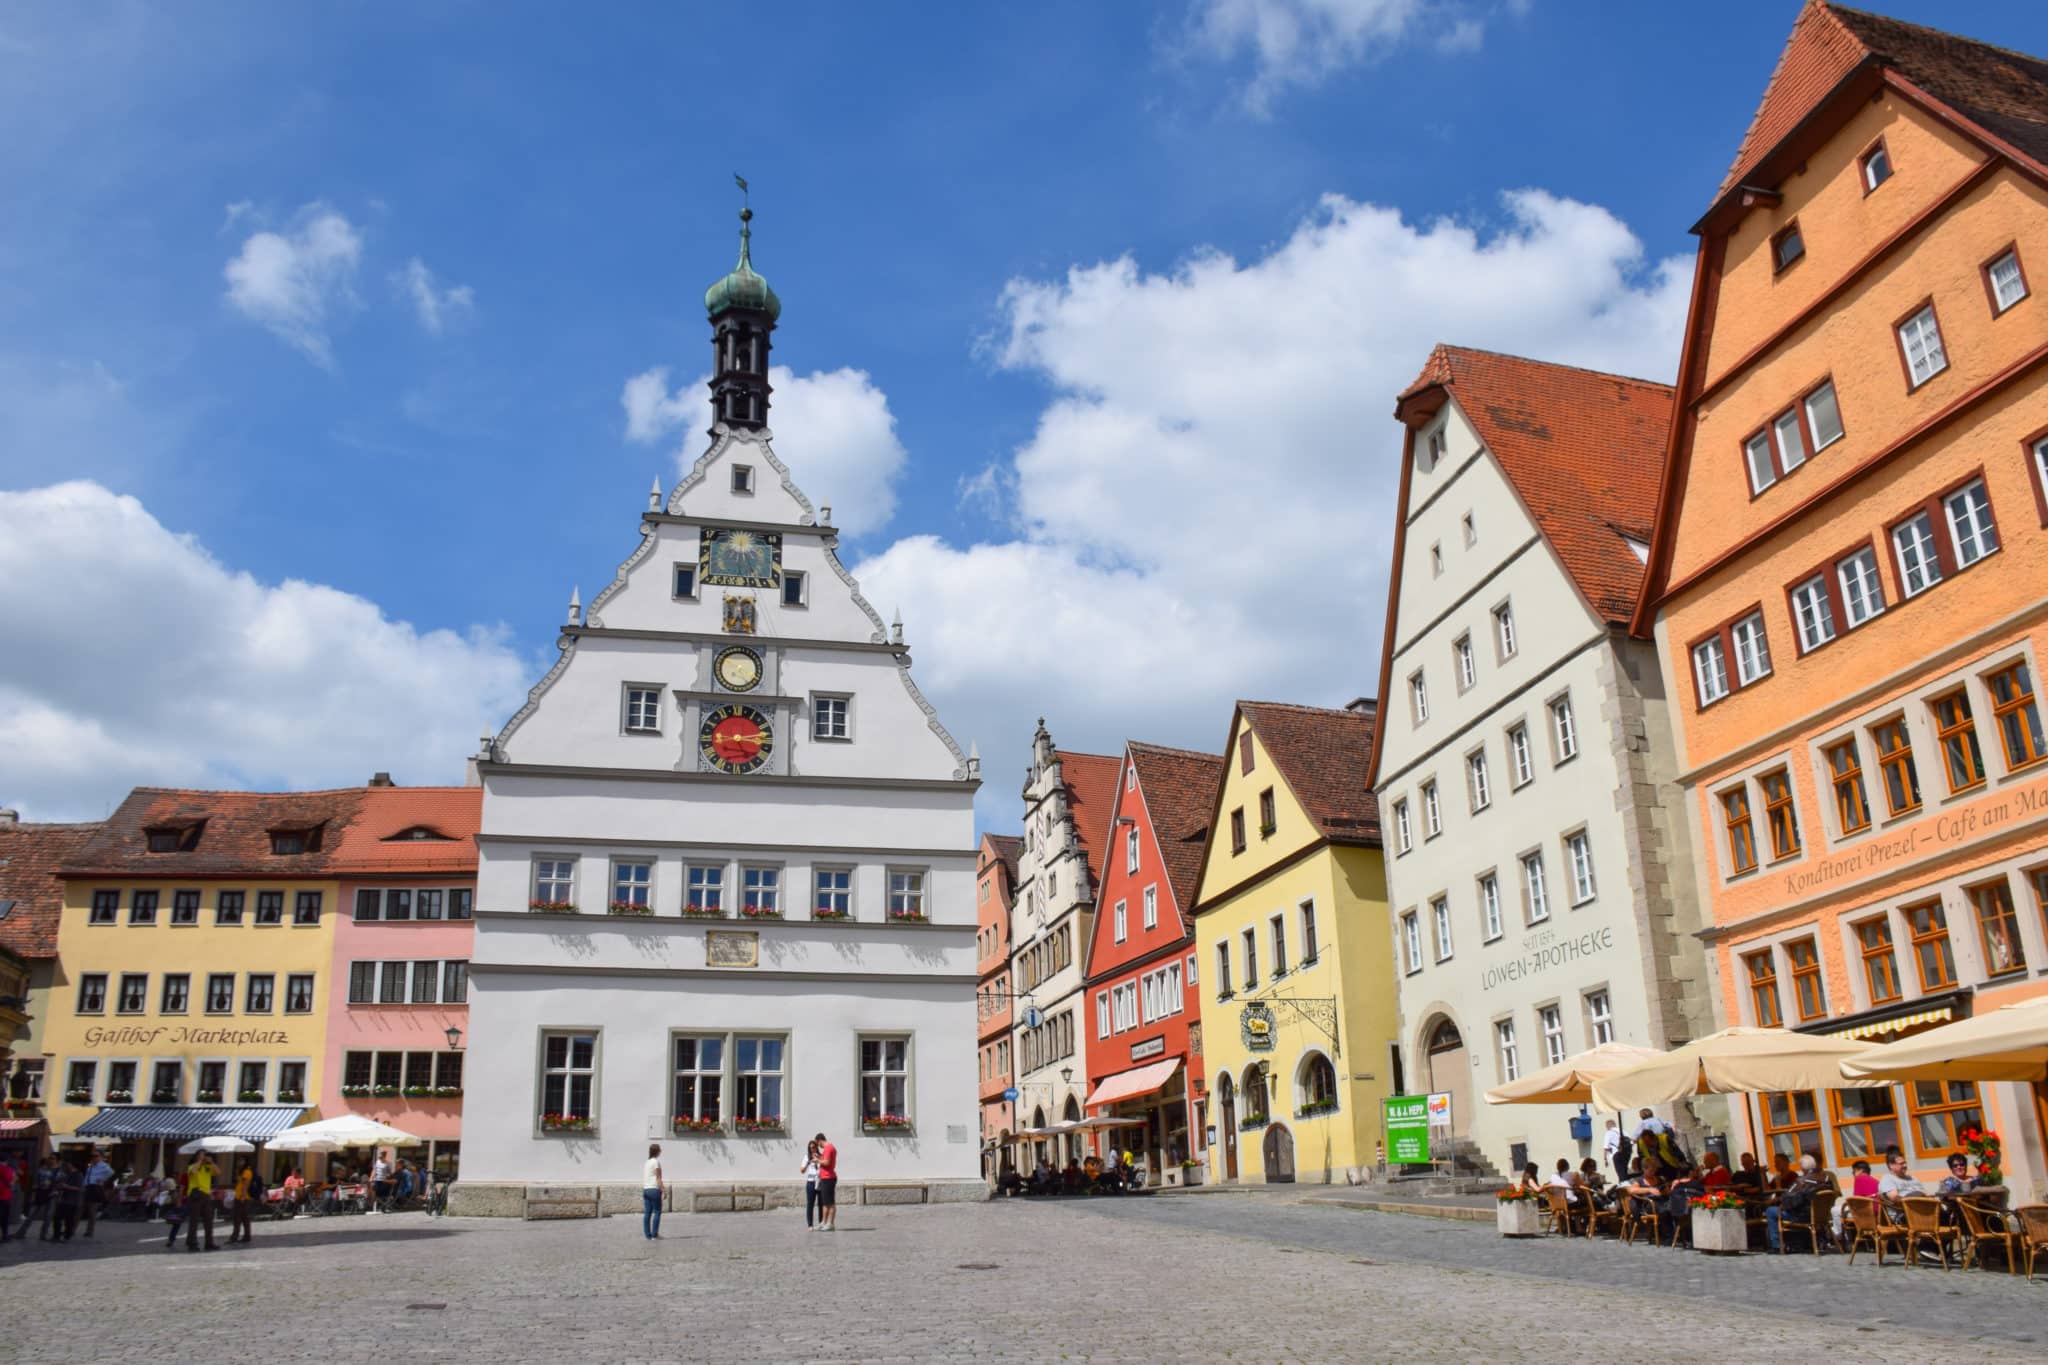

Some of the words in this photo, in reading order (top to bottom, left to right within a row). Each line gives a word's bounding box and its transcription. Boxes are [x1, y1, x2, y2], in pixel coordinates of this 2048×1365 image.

[1784, 850, 1863, 895] Konditorei
[1865, 828, 1917, 866] Prezel
[1937, 808, 1977, 842] Café
[1982, 806, 2009, 826] am
[170, 1026, 289, 1046] Marktplatz
